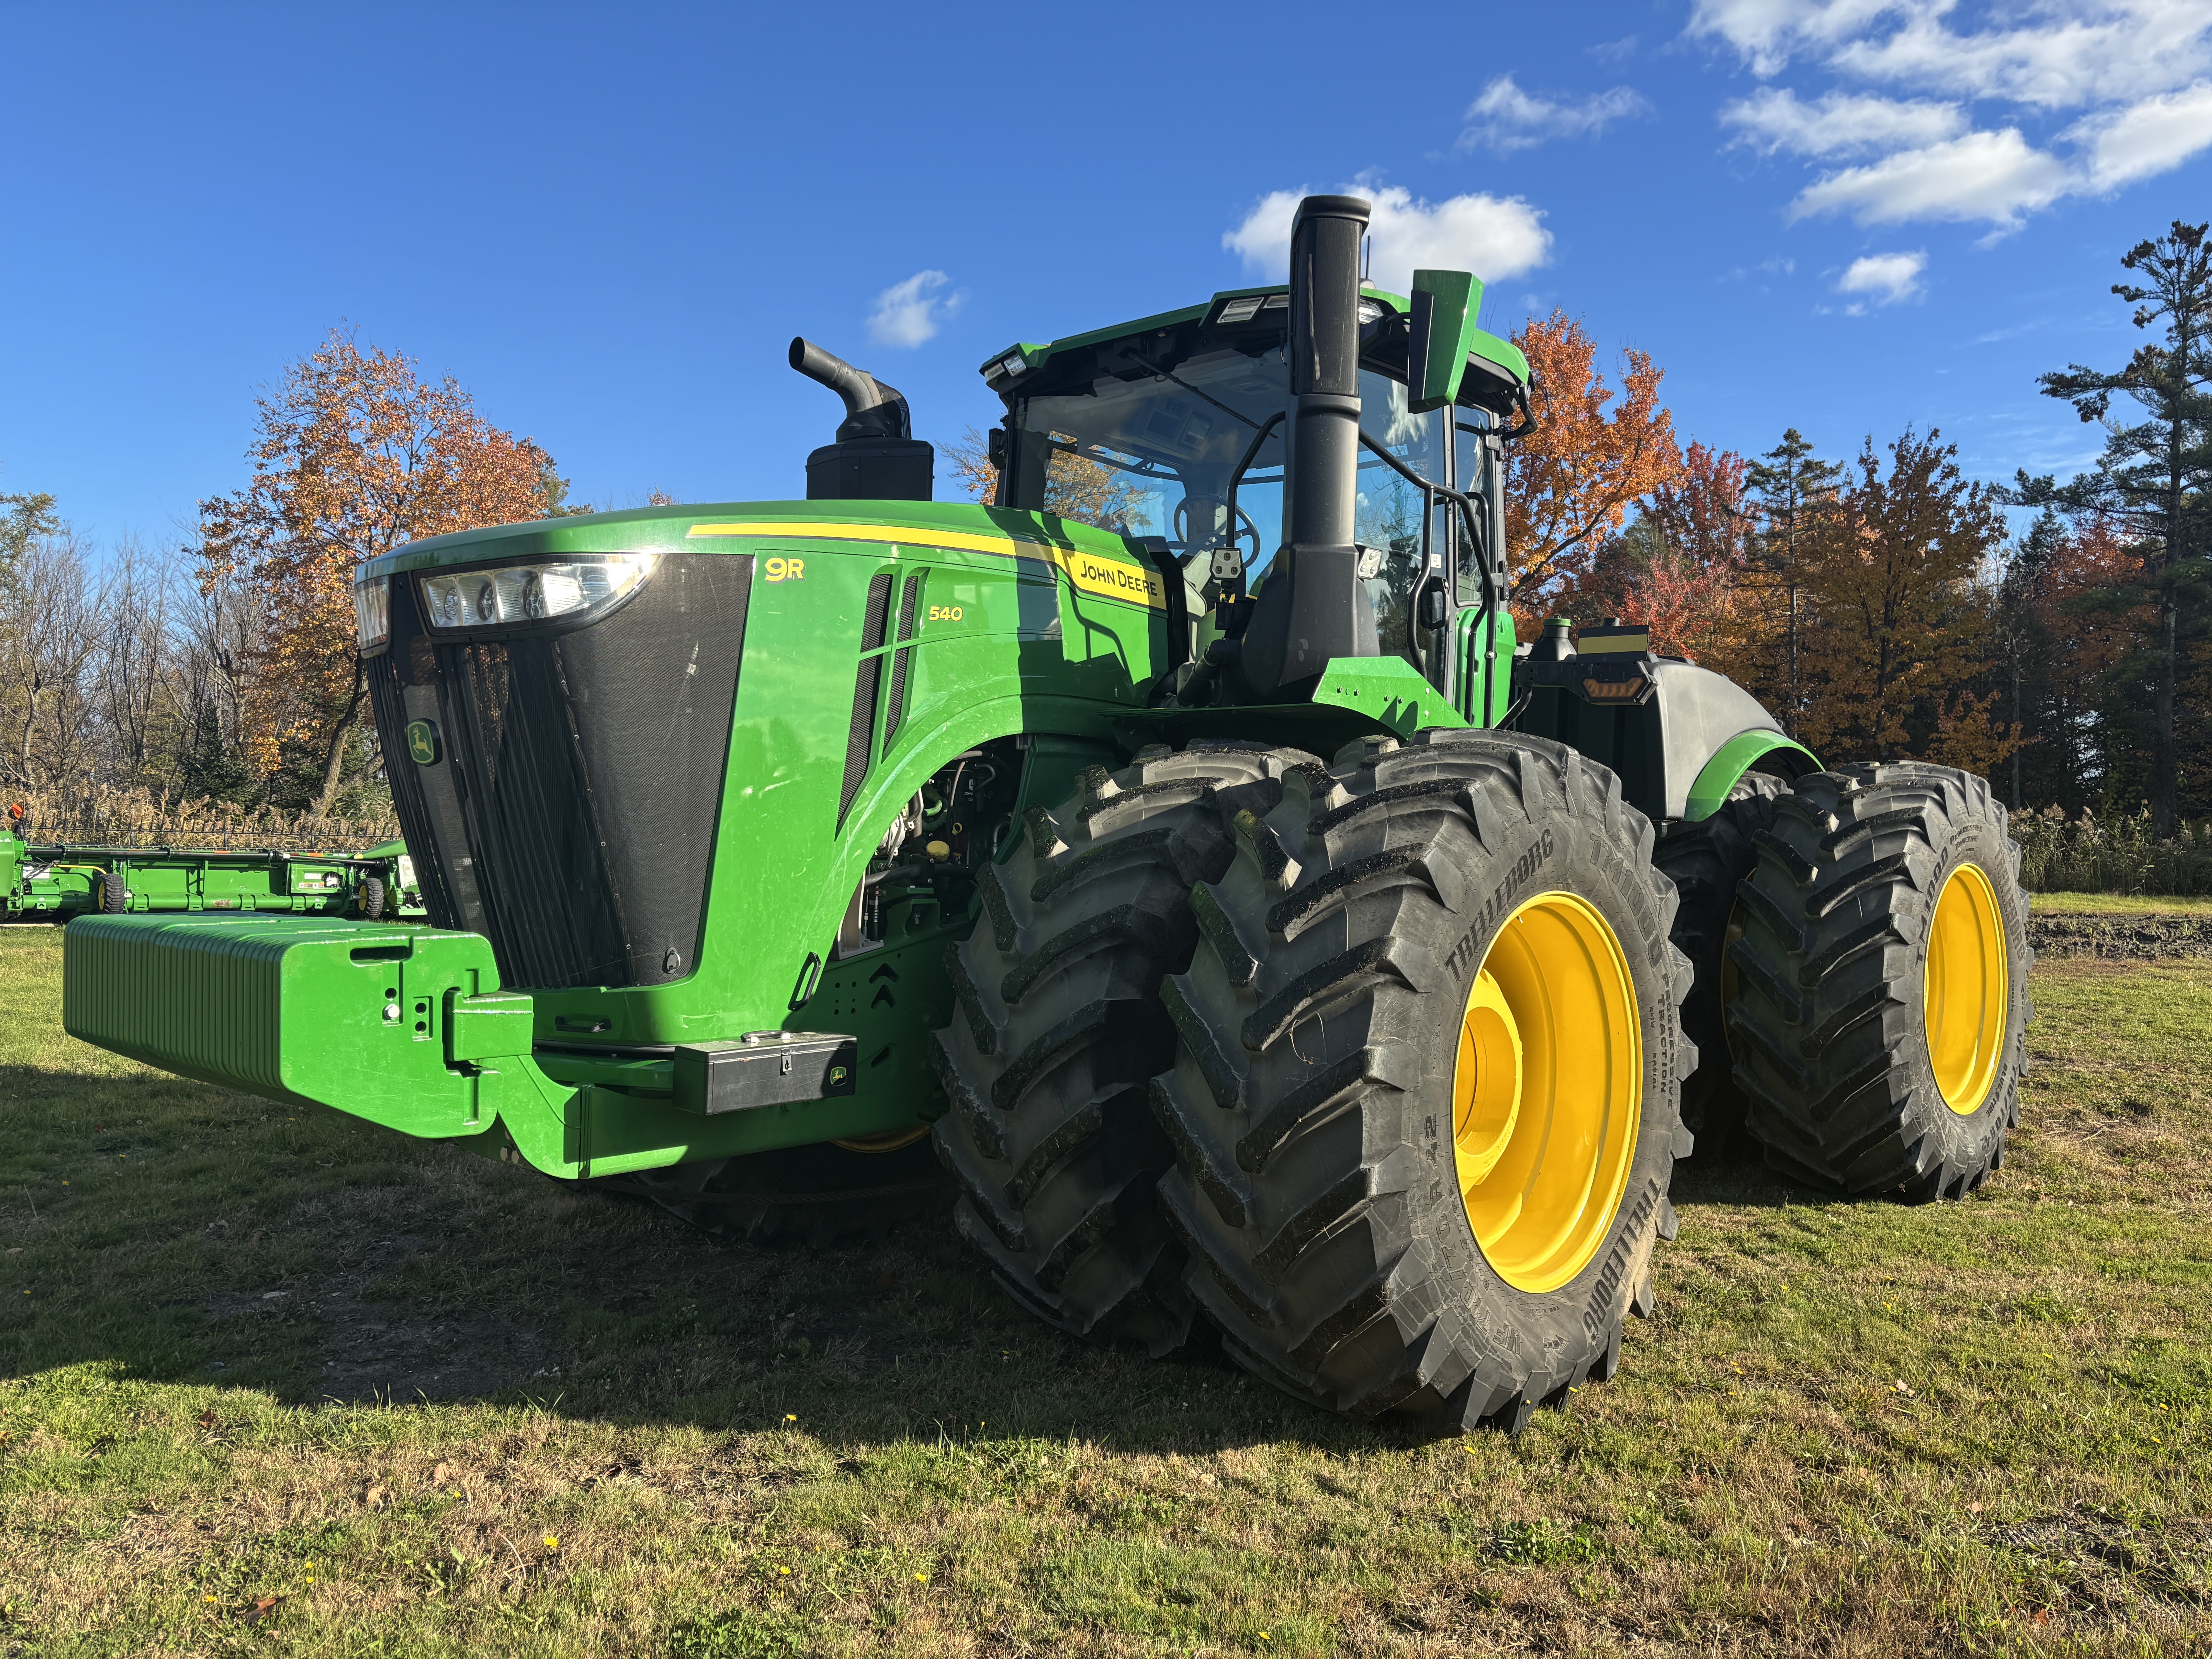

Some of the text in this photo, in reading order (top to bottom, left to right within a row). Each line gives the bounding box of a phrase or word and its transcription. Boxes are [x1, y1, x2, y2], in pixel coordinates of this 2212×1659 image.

[766, 557, 805, 583] 9R
[929, 606, 963, 622] 540
[1081, 560, 1158, 596] JOHN DEERE
[1444, 829, 1554, 984] TRELLEBORG
[1590, 831, 1662, 969] TM1000
[1915, 846, 1948, 968] TM1000
[1995, 843, 2026, 962] TRELLEBORG
[1657, 994, 1668, 1094] TRACTION
[1662, 972, 1674, 1110] PROGRESSIVE
[1583, 1178, 1661, 1343] TRELLEBORG
